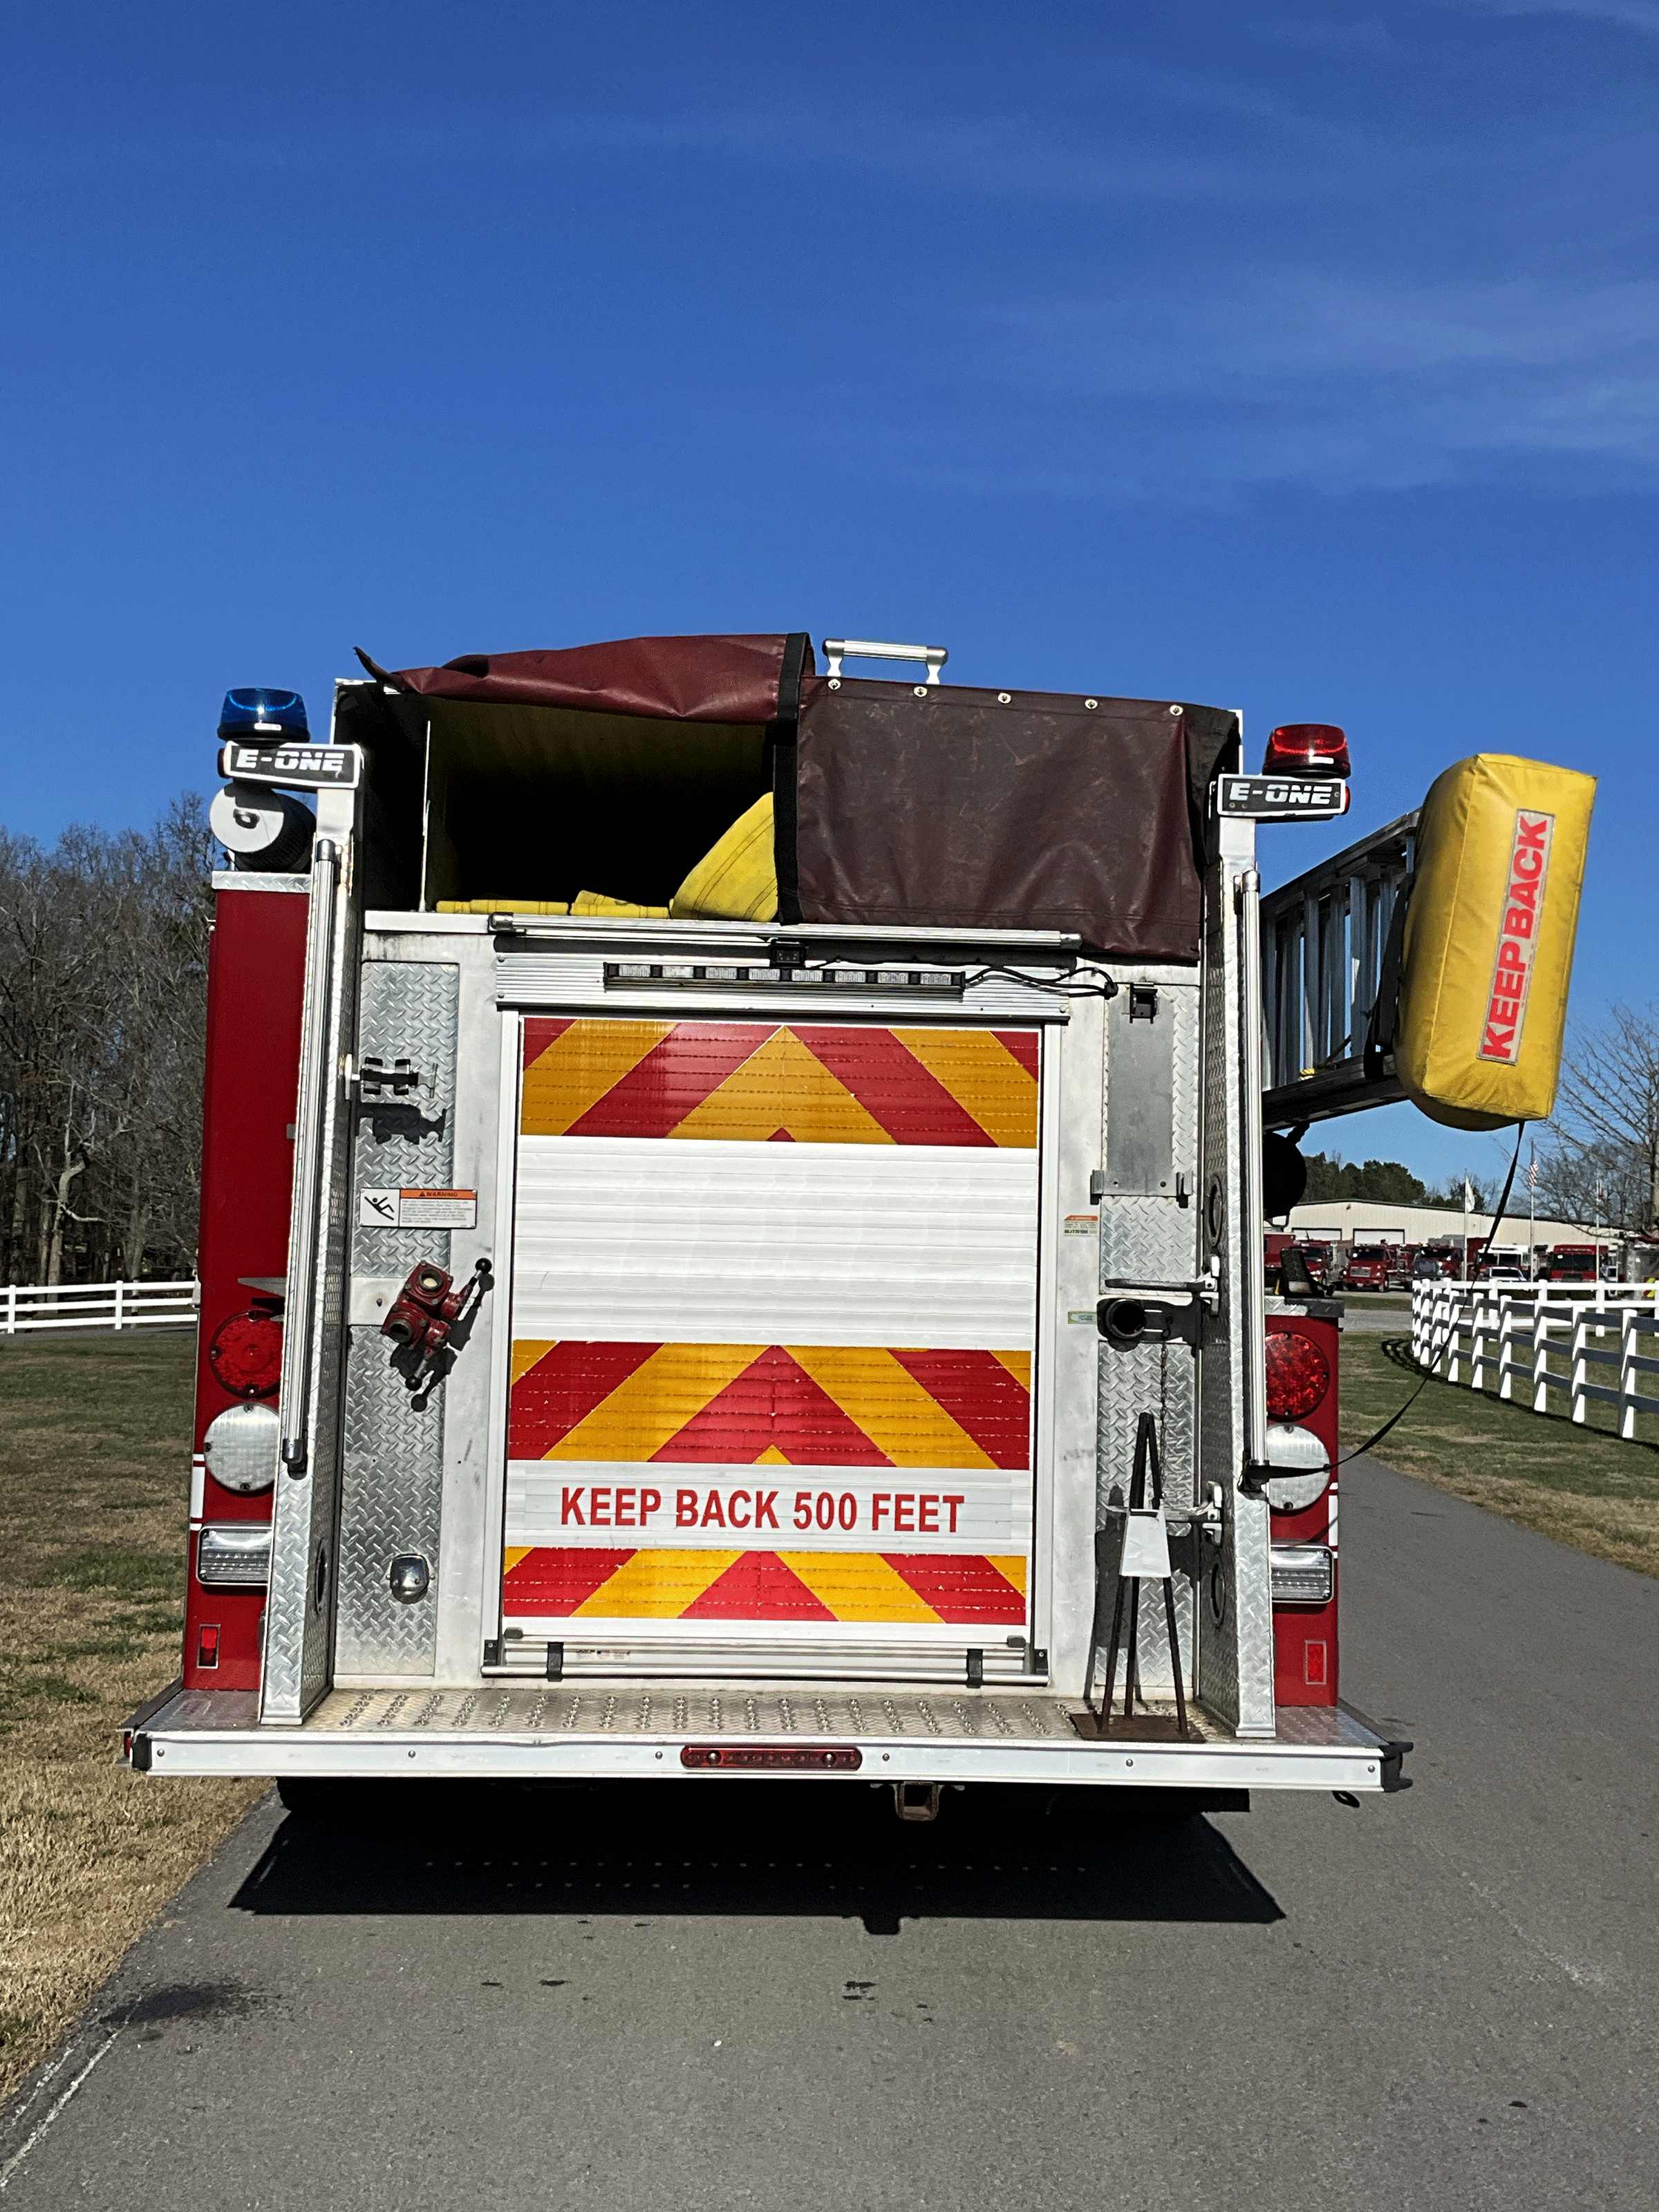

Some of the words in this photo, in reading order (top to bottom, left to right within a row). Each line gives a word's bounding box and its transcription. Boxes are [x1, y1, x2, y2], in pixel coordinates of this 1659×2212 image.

[236, 749, 345, 771] E-ONE
[1229, 782, 1333, 805] E-ONE
[1503, 815, 1548, 939] BACK
[1481, 941, 1527, 1059] KEEP
[561, 1487, 662, 1526] KEEP
[676, 1489, 780, 1528] BACK
[793, 1492, 857, 1530] 500
[872, 1493, 964, 1533] FEET
